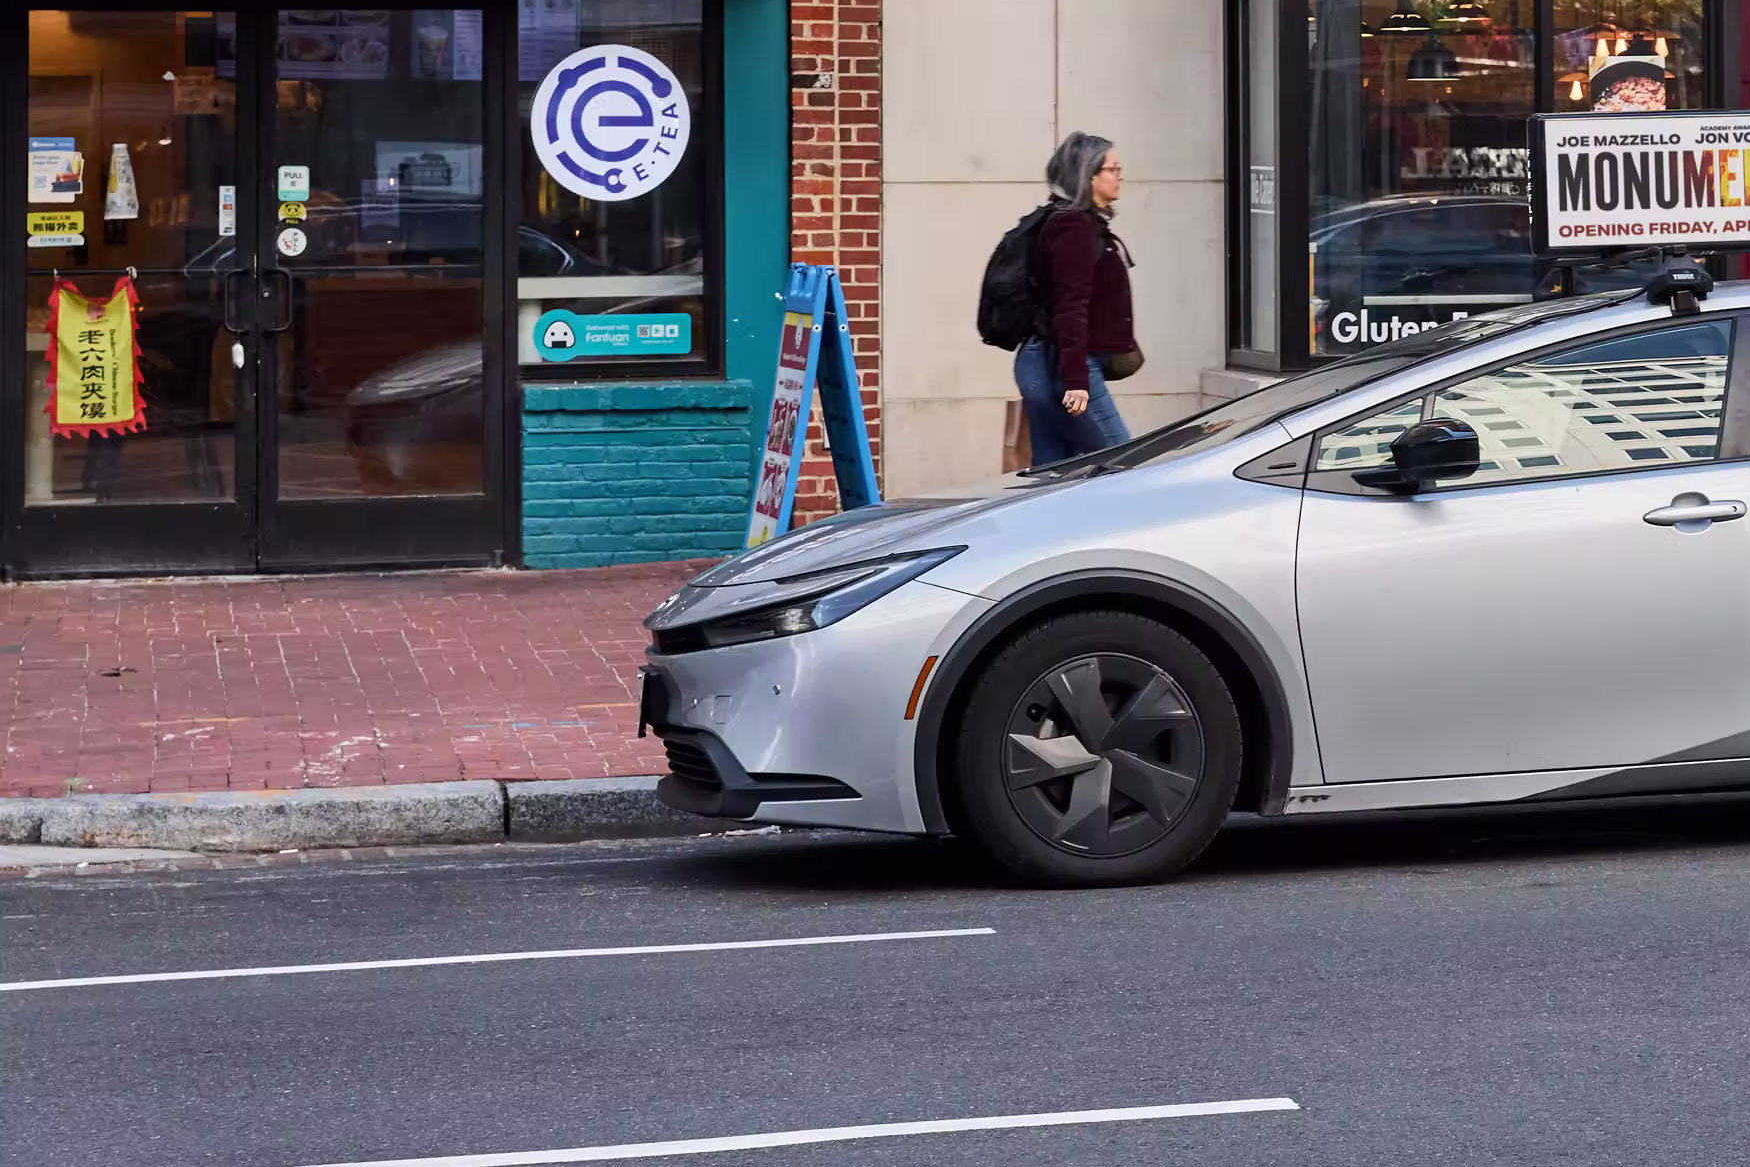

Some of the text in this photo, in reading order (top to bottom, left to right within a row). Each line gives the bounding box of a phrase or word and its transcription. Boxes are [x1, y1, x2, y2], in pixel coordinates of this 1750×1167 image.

[1699, 124, 1732, 132] ACADEMY
[1556, 136, 1590, 148] JOE
[1594, 133, 1682, 147] MAZZELLO
[1695, 131, 1729, 145] JON
[283, 172, 304, 180] PULL
[1558, 222, 1645, 238] OPENING
[1649, 220, 1718, 235] FRIDAY,
[585, 333, 630, 343] Fantuan
[78, 329, 107, 419] 老六肉夹馍
